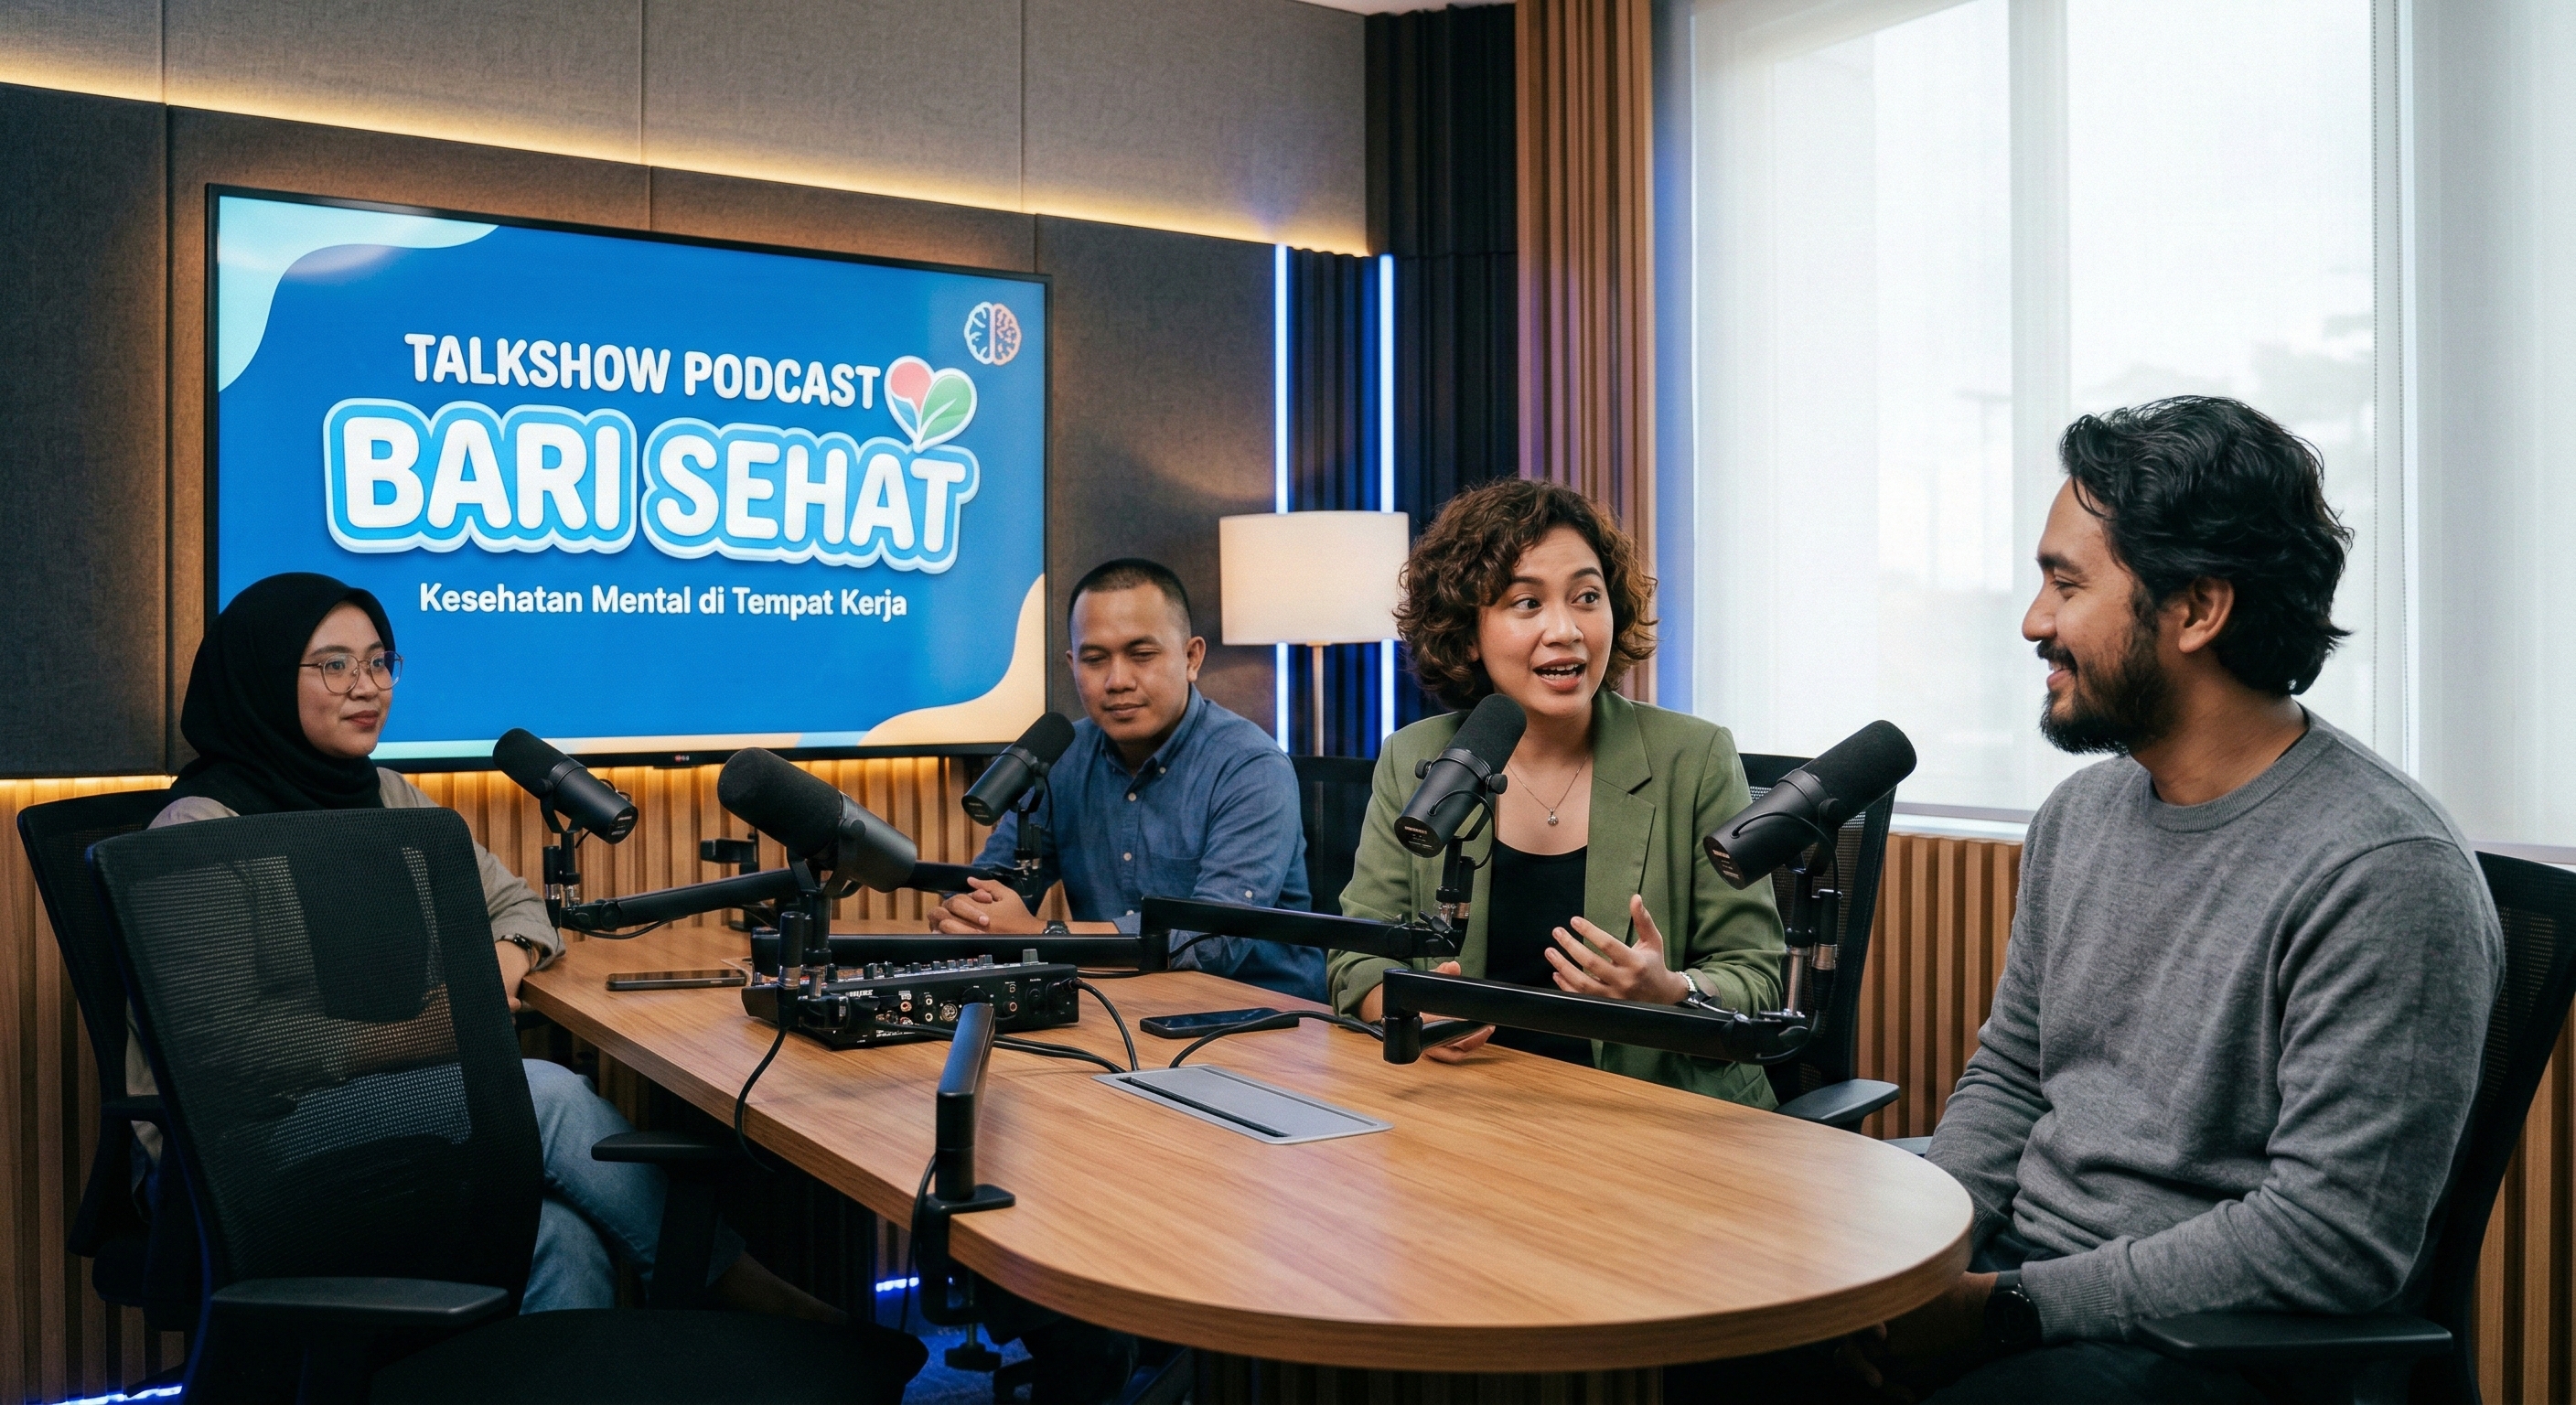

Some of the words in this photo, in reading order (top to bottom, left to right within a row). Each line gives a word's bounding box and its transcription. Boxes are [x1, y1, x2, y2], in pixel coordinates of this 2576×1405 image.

[404, 333, 672, 395] TALKSHOW
[683, 351, 882, 410] PODCAST
[340, 413, 624, 532] BARI
[654, 431, 970, 554] SEHAT
[420, 583, 583, 613] Kesehatan
[592, 585, 691, 614] Mental
[698, 586, 724, 614] di
[732, 586, 833, 621] Tempat
[841, 589, 907, 622] Kerja
